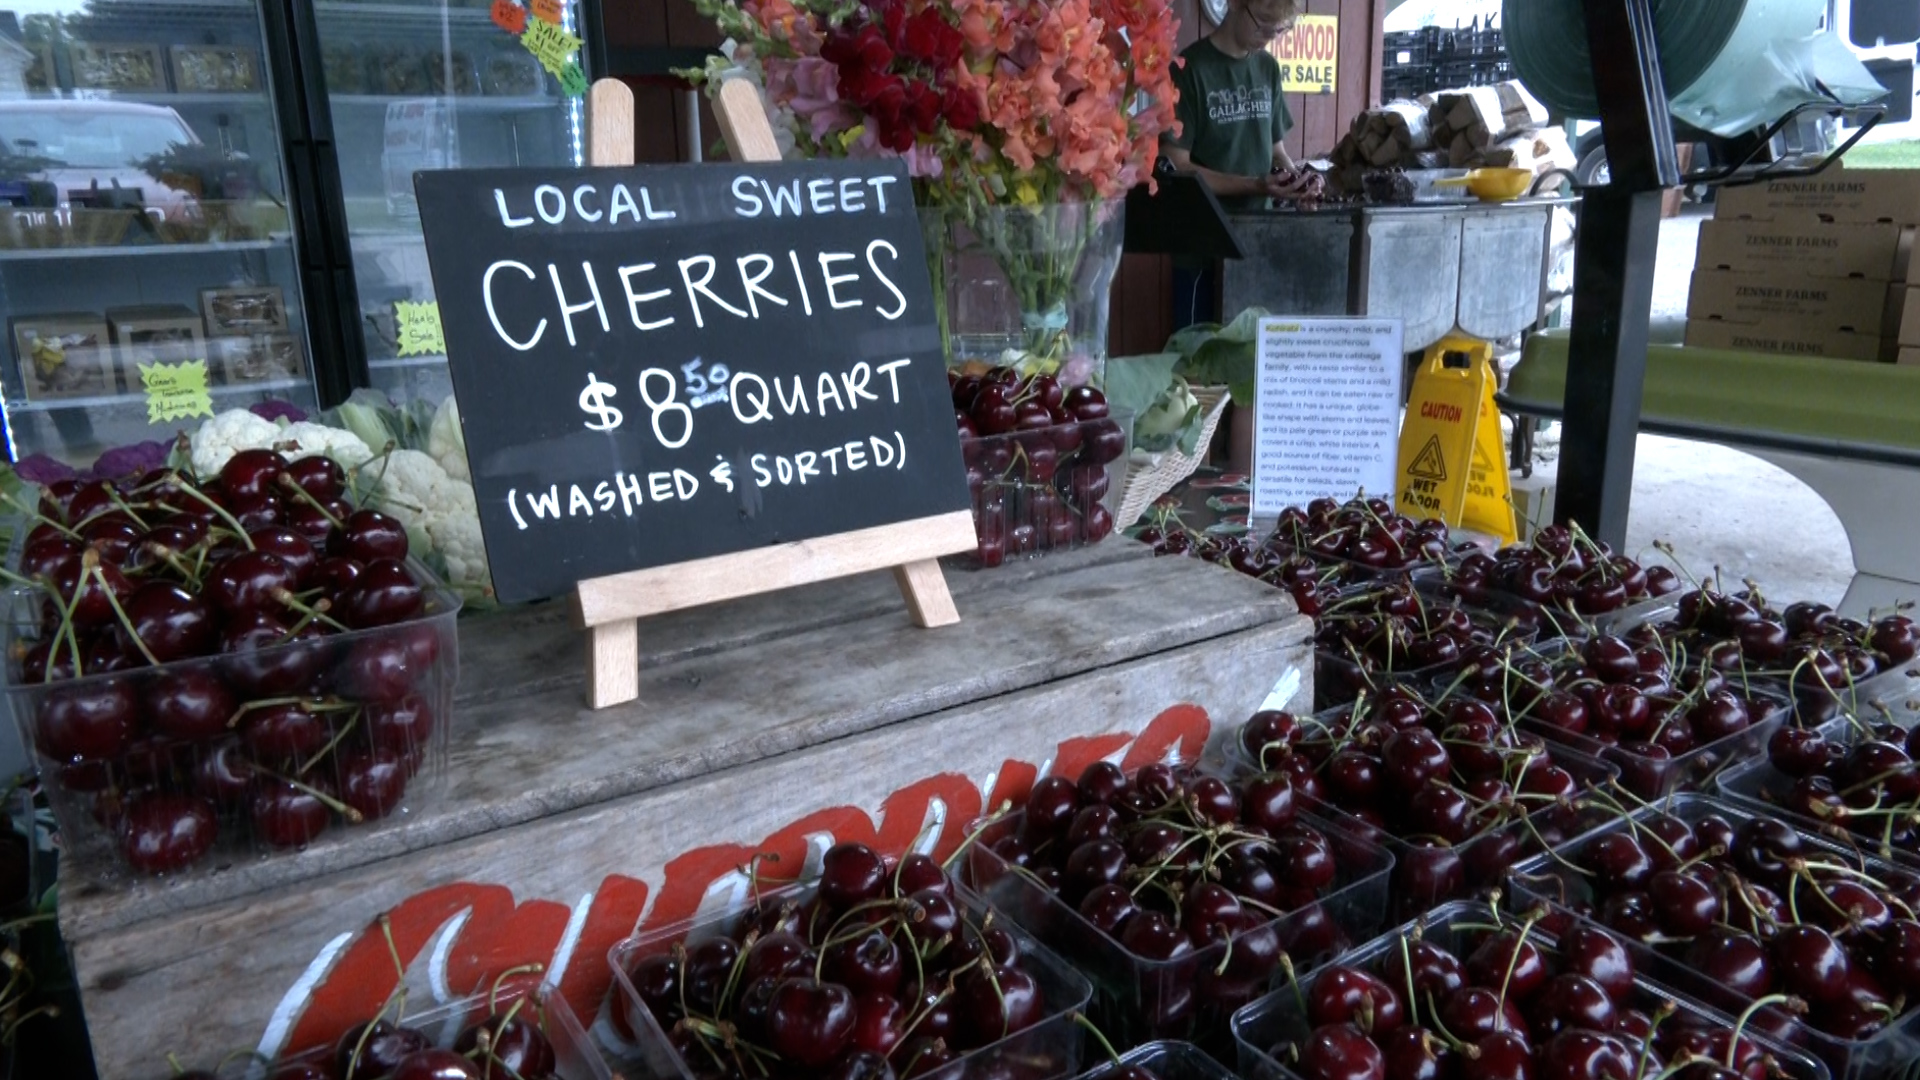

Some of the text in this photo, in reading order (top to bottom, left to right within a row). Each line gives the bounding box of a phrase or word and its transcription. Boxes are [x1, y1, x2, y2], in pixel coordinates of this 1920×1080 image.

[1270, 23, 1335, 60] IREWOOD
[1295, 65, 1333, 83] SALE
[1767, 181, 1867, 195] ZENNER FARMS
[494, 175, 898, 229] LOCAL SWEET
[1745, 234, 1839, 249] ZENNER FARMS
[482, 239, 908, 350] CHERRIES
[1735, 286, 1829, 301] ZENNER FARMS
[1375, 326, 1392, 334] and
[1732, 337, 1824, 352] ZENNER FARMS
[1265, 351, 1381, 361] vegetable from the cabbage
[729, 358, 912, 425] QUART
[1303, 402, 1317, 410] has
[1421, 400, 1463, 424] CAUTION
[1277, 414, 1301, 423] shape
[1289, 427, 1307, 435] pale
[1307, 428, 1332, 436] green
[1343, 428, 1369, 437] purple
[1371, 429, 1387, 437] skin
[1318, 440, 1340, 448] white
[1261, 451, 1282, 460] good
[1343, 453, 1373, 462] vitamin
[507, 467, 700, 531] (WASHED
[750, 430, 906, 488] SORTED)
[1260, 475, 1293, 483] versatile
[1413, 478, 1438, 493] WET
[1274, 500, 1286, 508] be
[1403, 491, 1441, 511] FLOOR
